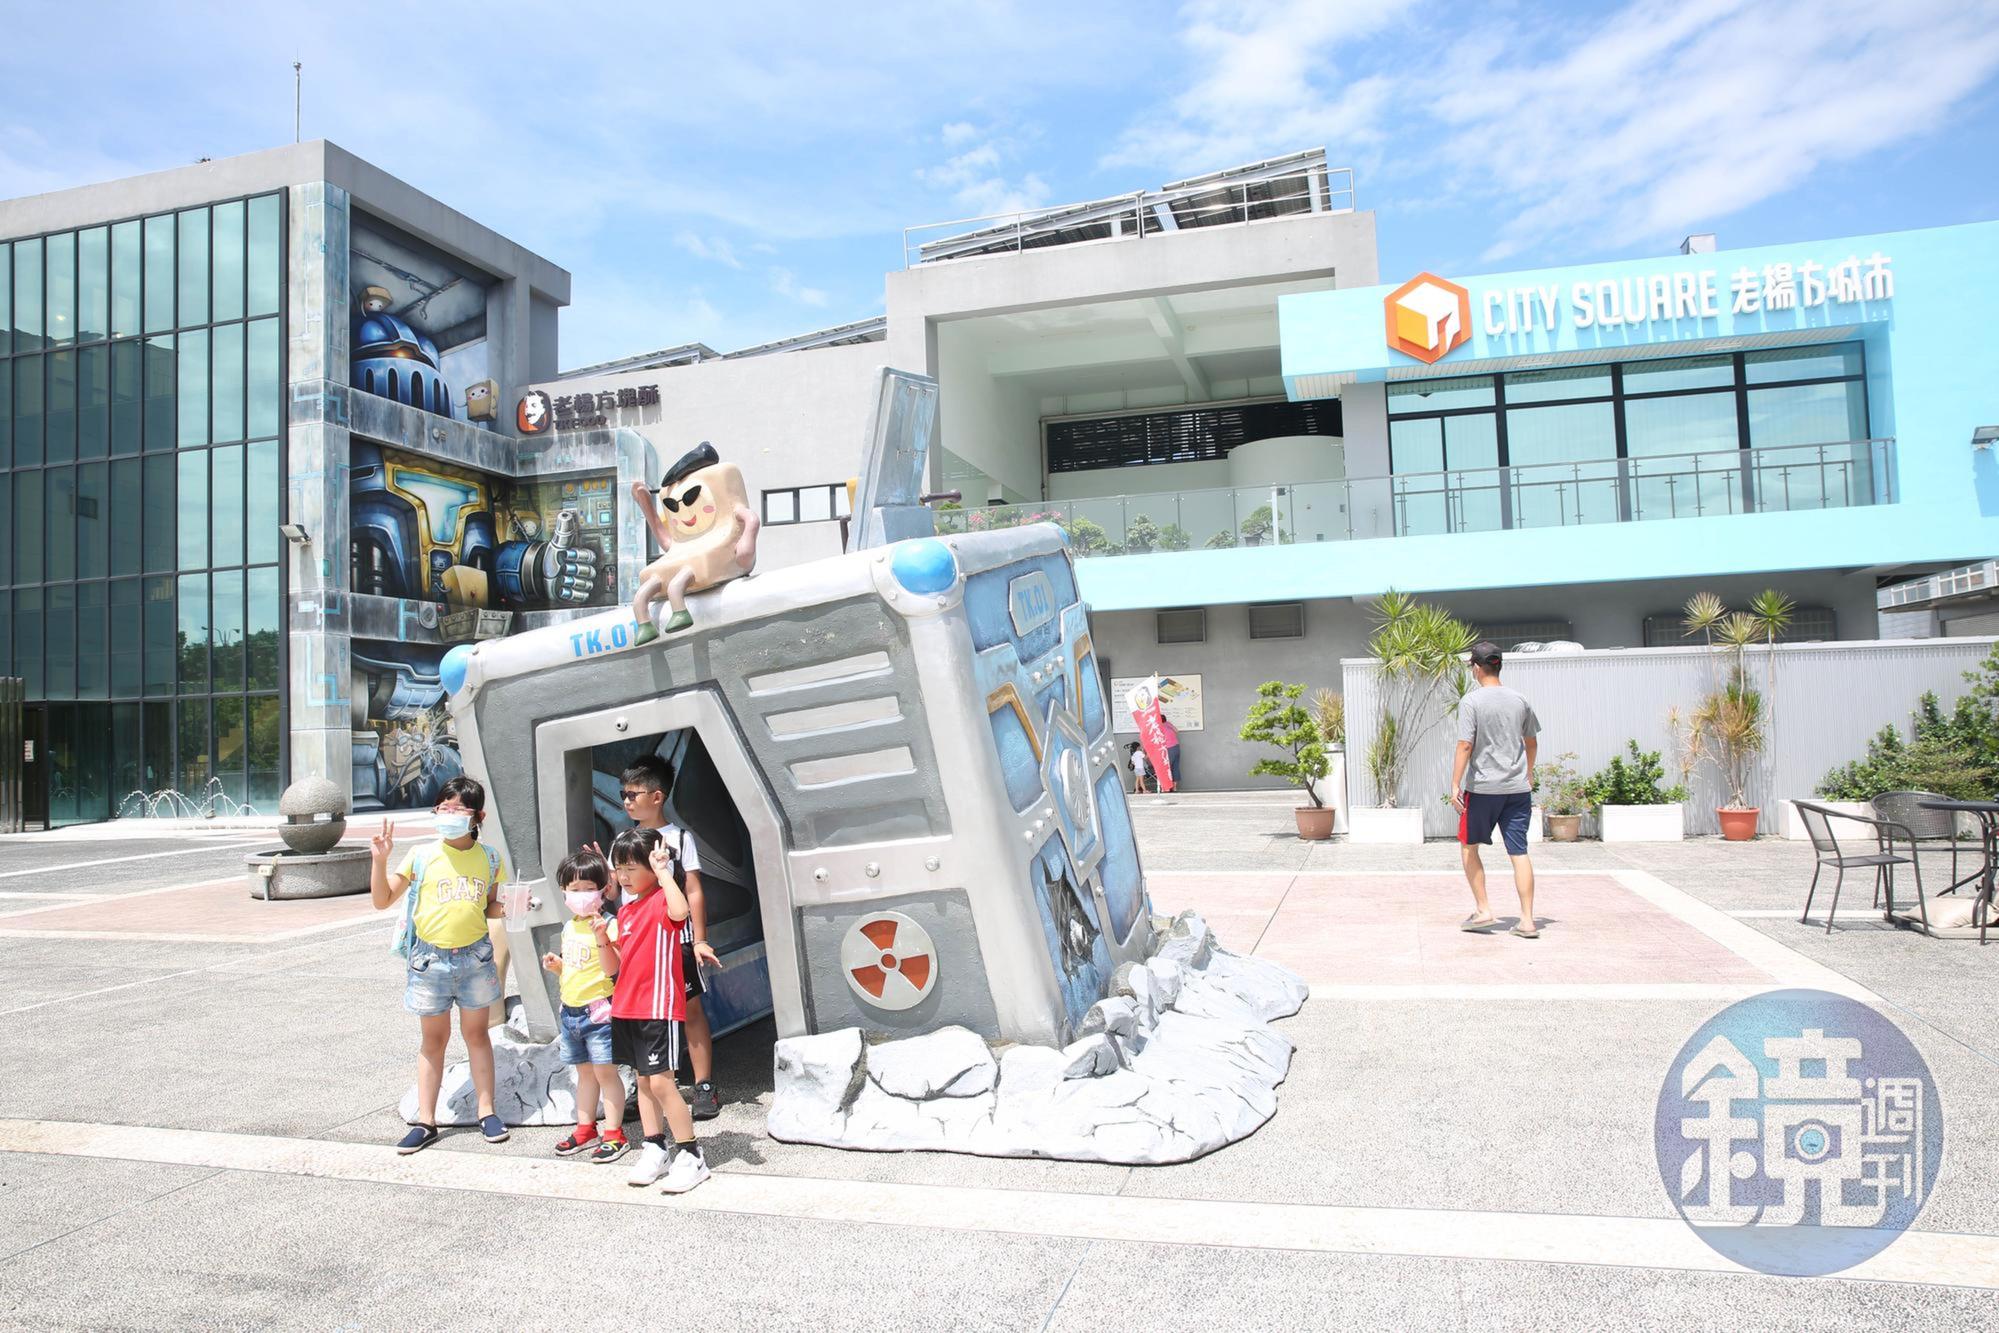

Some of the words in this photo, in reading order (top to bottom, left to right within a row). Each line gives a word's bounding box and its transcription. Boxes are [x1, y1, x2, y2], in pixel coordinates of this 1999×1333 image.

[1482, 283, 1560, 337] CITY
[1571, 268, 1720, 329] SQUARE
[1730, 250, 1896, 315] 老楊方城市
[552, 384, 660, 417] 老楊方塊酥
[1017, 582, 1049, 622] TK.01
[437, 875, 486, 904] GAP
